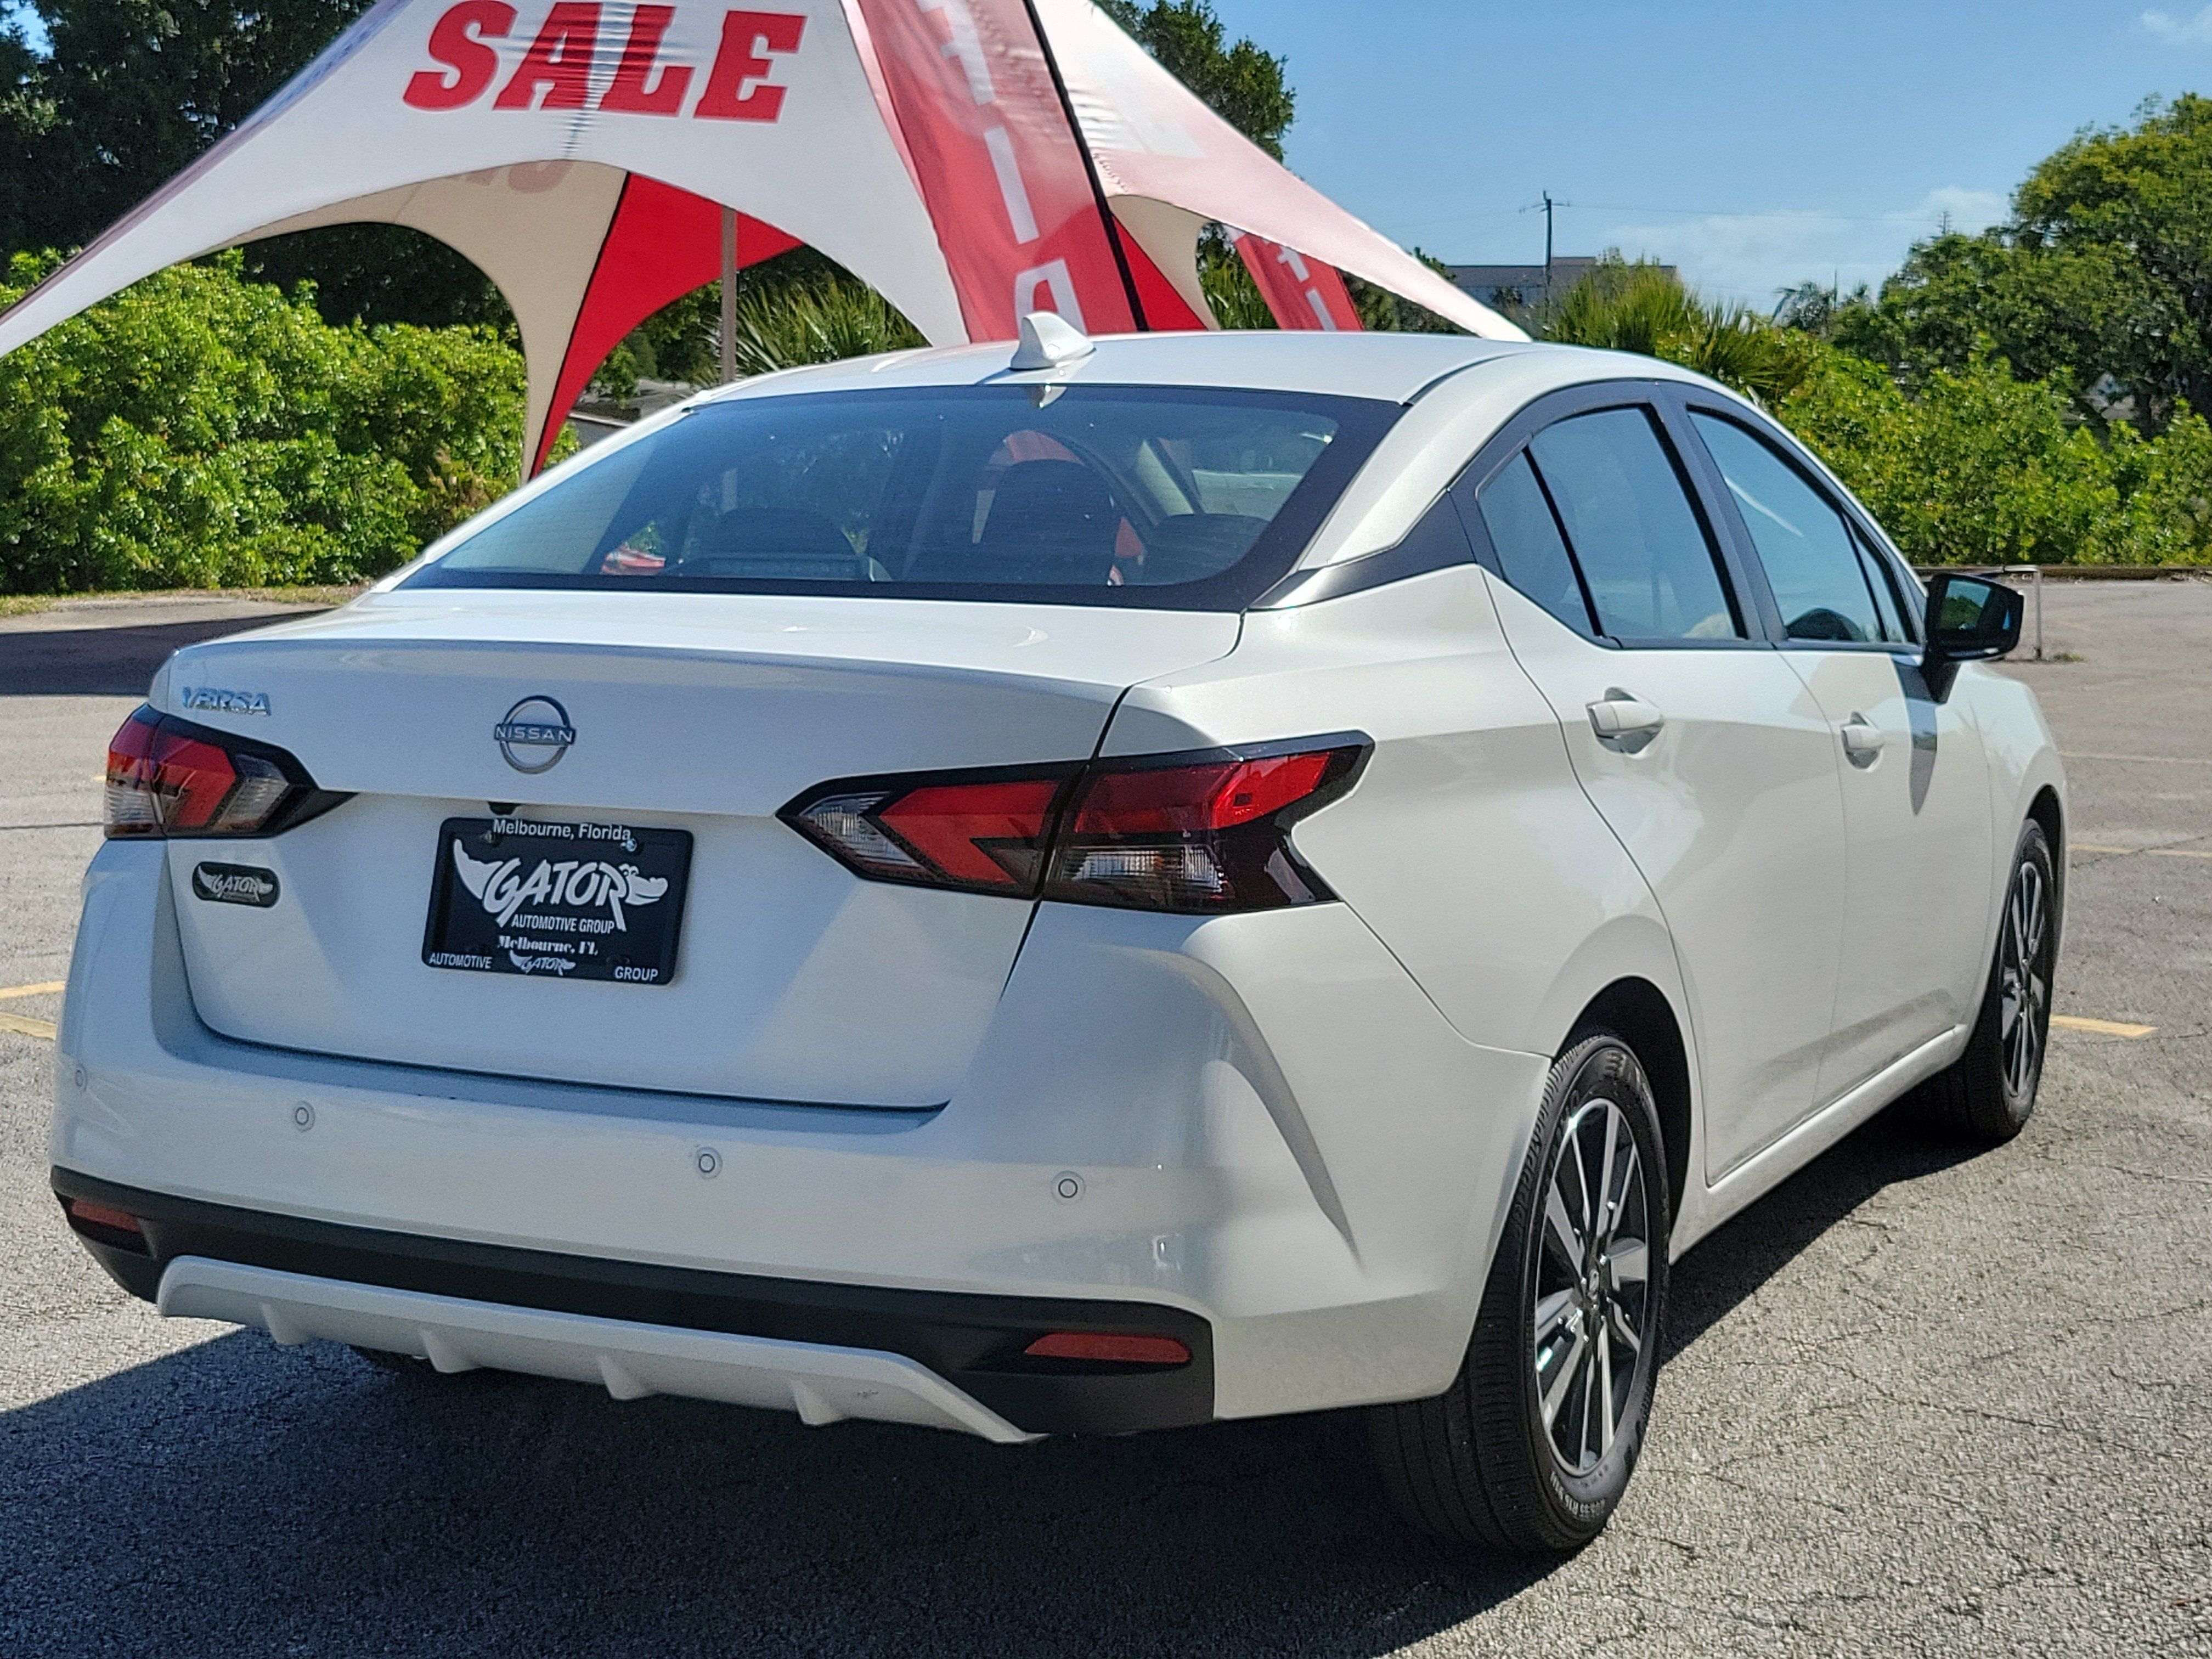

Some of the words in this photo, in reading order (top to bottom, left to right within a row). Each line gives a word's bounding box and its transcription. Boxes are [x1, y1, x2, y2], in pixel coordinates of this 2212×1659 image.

[403, 0, 807, 123] SALE
[182, 686, 272, 716] VERSA
[495, 725, 572, 743] NISSAN
[493, 819, 574, 840] Melbourne,
[578, 823, 631, 840] Florida
[212, 874, 260, 902] GATOR
[483, 857, 627, 932] GATOR
[511, 914, 577, 932] AUTOMOTIVE
[579, 918, 615, 934] GROUP
[429, 952, 492, 969] AUTOMOTIVE
[614, 966, 658, 982] GROUP
